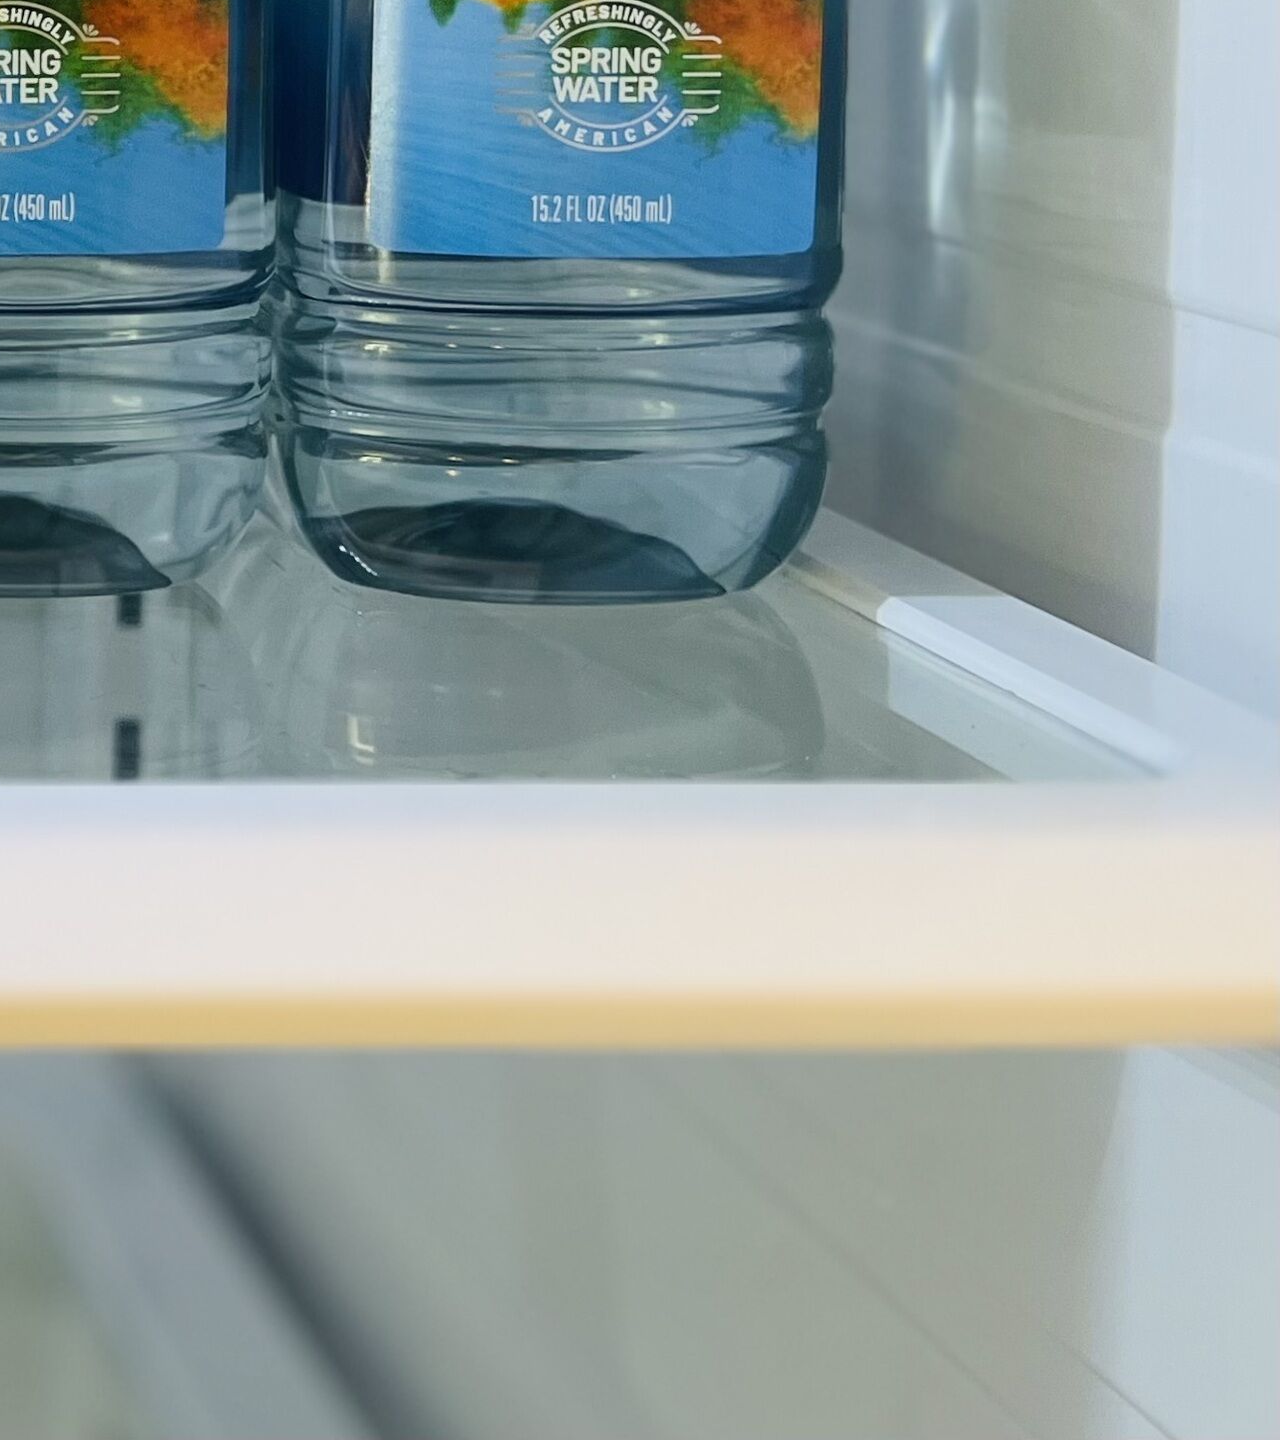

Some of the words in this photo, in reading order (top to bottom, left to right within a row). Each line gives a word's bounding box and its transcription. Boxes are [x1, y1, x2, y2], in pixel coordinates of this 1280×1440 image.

[538, 4, 677, 45] REFRESHINGLY
[550, 46, 662, 74] SPRING
[552, 76, 659, 103] WATER
[537, 106, 674, 146] AMERICAN
[13, 192, 45, 223] (450
[48, 192, 75, 222] mL)
[531, 194, 561, 223] 15.2
[566, 194, 582, 223] FL
[587, 194, 606, 223] OZ
[609, 193, 641, 225] (450
[645, 193, 672, 225] mL)
